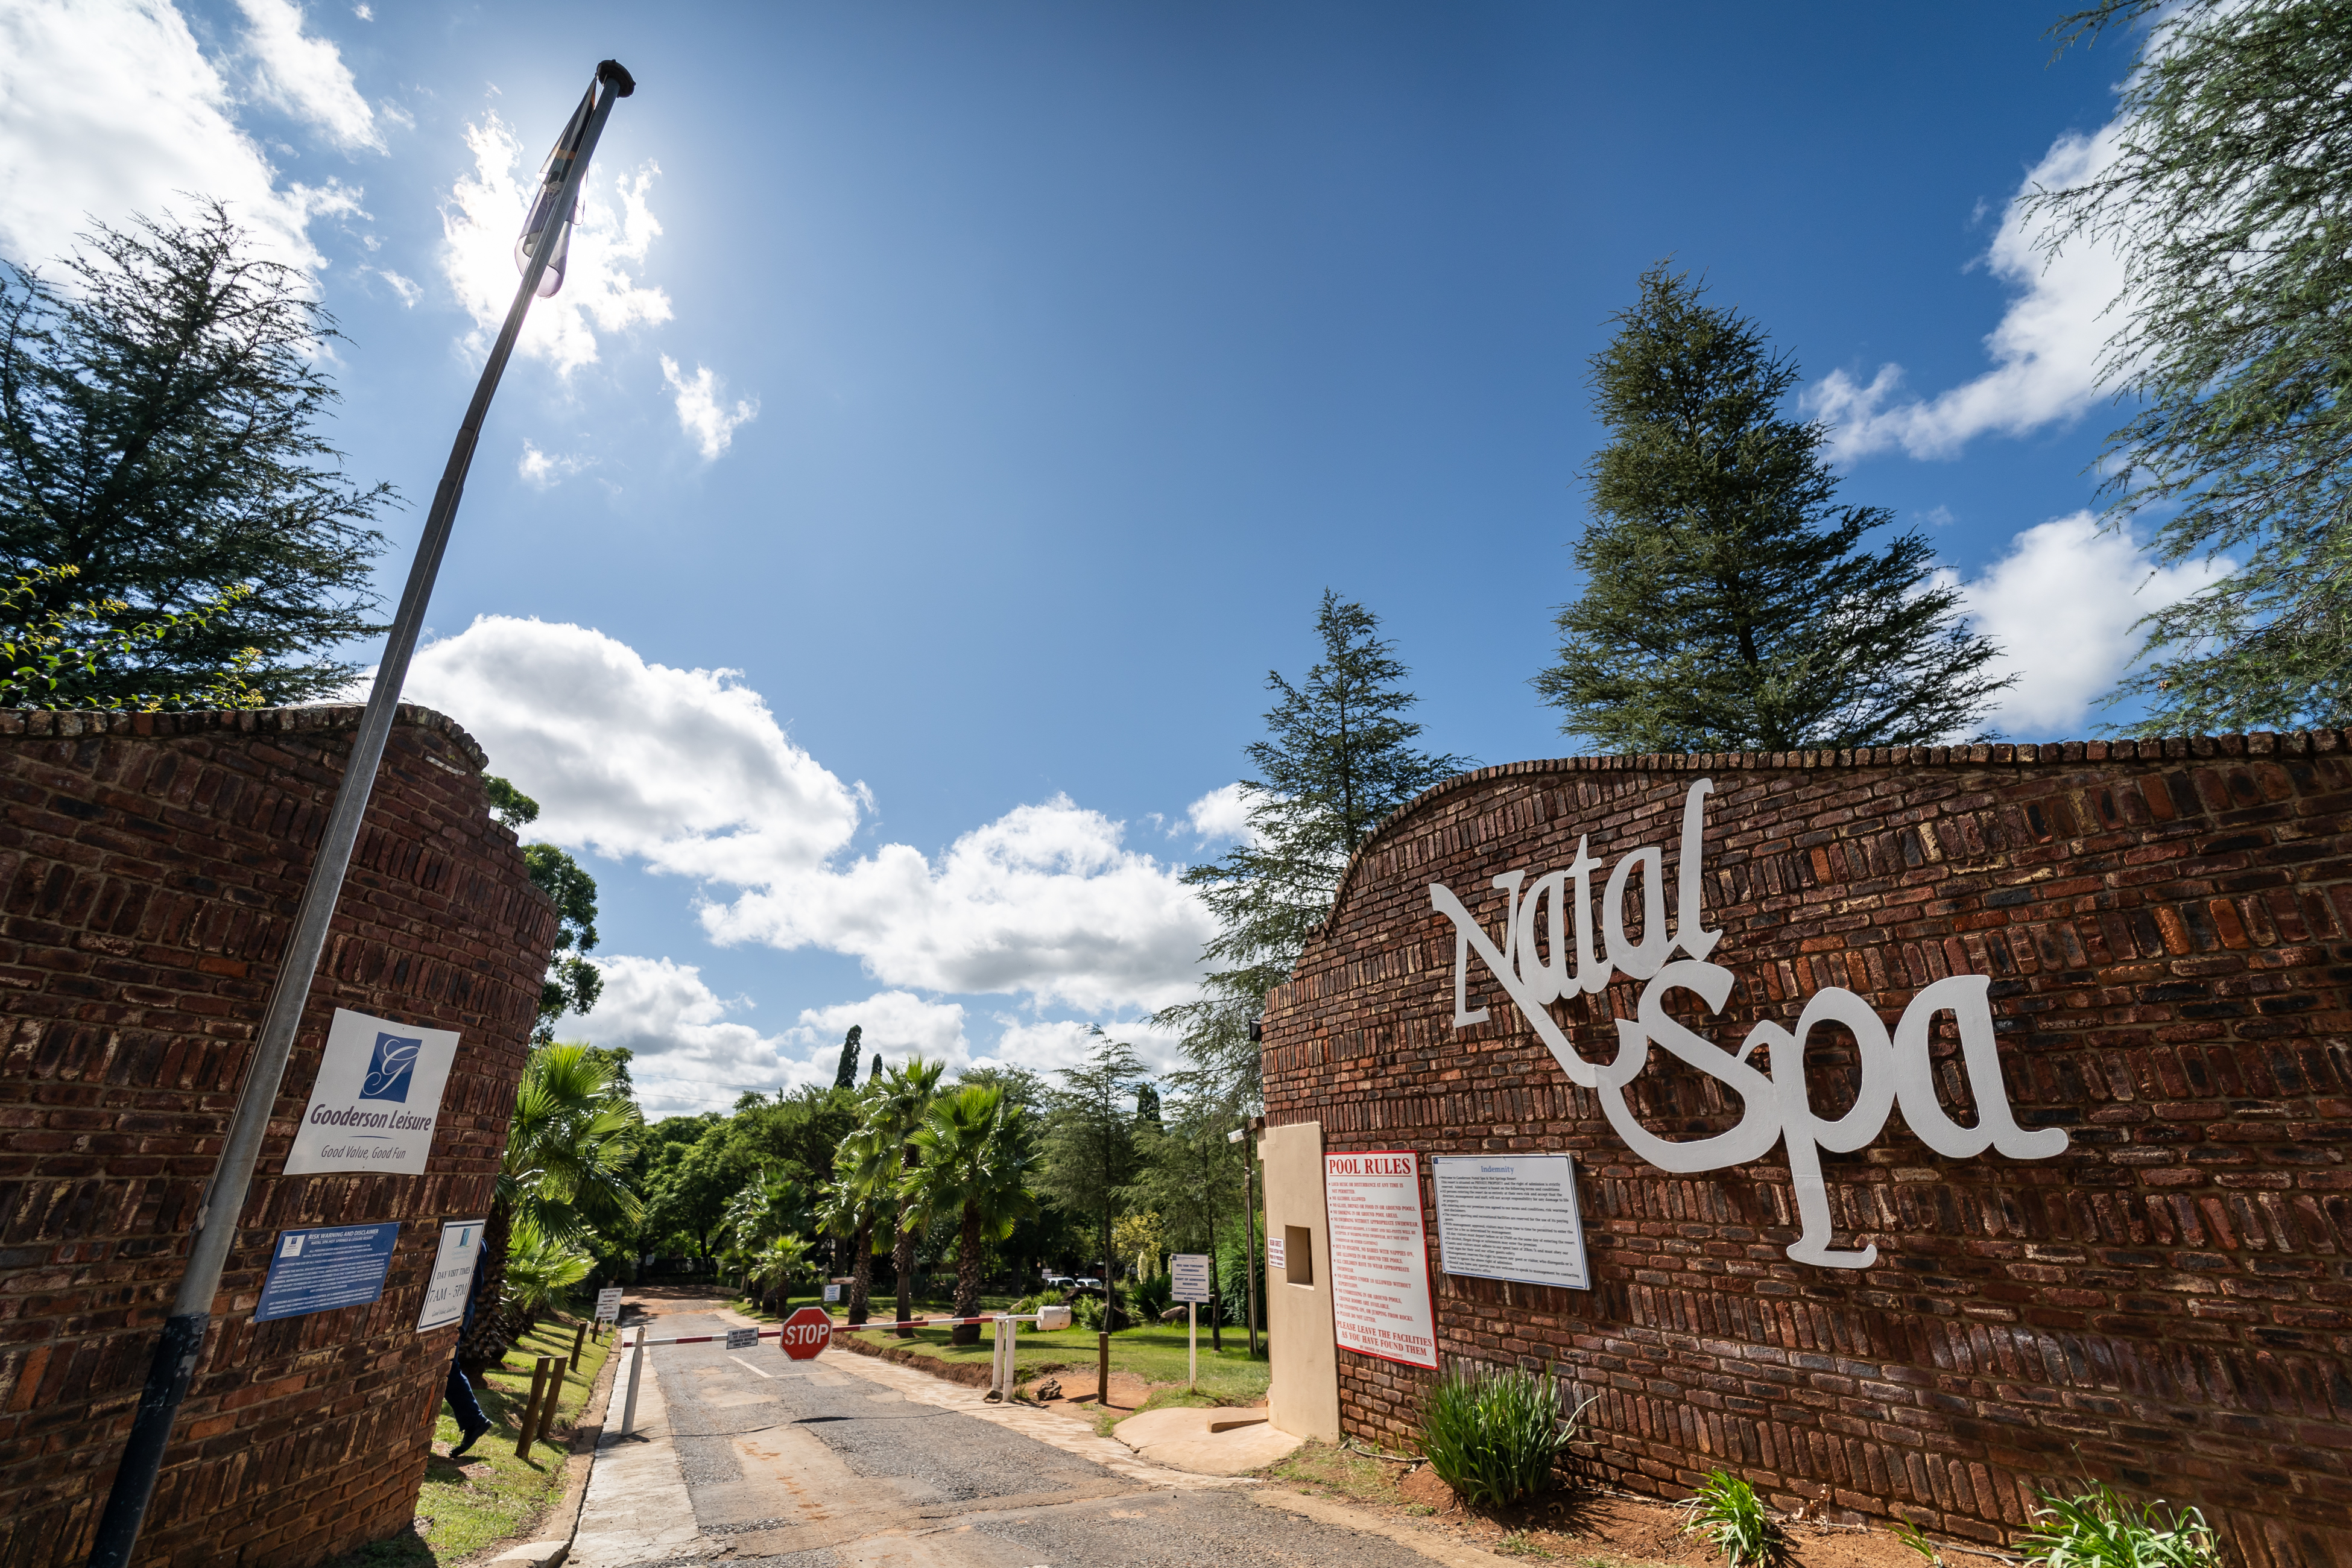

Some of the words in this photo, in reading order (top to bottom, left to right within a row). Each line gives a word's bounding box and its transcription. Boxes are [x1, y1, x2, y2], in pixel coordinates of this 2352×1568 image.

[1429, 777, 1722, 1087] Natal
[310, 1104, 389, 1128] Gooderson
[388, 1110, 432, 1131] Leisure
[1598, 959, 2069, 1268] Spa
[321, 1145, 346, 1158] Good
[346, 1146, 368, 1160] Value,
[372, 1146, 393, 1159] Good
[392, 1147, 406, 1159] Fun
[1329, 1159, 1360, 1174] POOL
[1364, 1158, 1411, 1174] RULES
[1481, 1165, 1514, 1175] Indemnity
[437, 1271, 448, 1279] DAY
[448, 1269, 459, 1278] VISIT
[459, 1266, 471, 1276] TIMES
[429, 1287, 447, 1303] 7AM
[453, 1283, 467, 1298] 5PM
[785, 1324, 829, 1345] STOP
[1337, 1321, 1355, 1331] PLEASE
[1357, 1325, 1376, 1335] LEAVE
[1378, 1329, 1390, 1338] THE
[1393, 1332, 1432, 1347] FACILITIES
[1349, 1333, 1359, 1341] YOU
[1362, 1335, 1378, 1345] HAVE
[1380, 1339, 1403, 1351] FOUND
[1405, 1344, 1426, 1356] THEM
